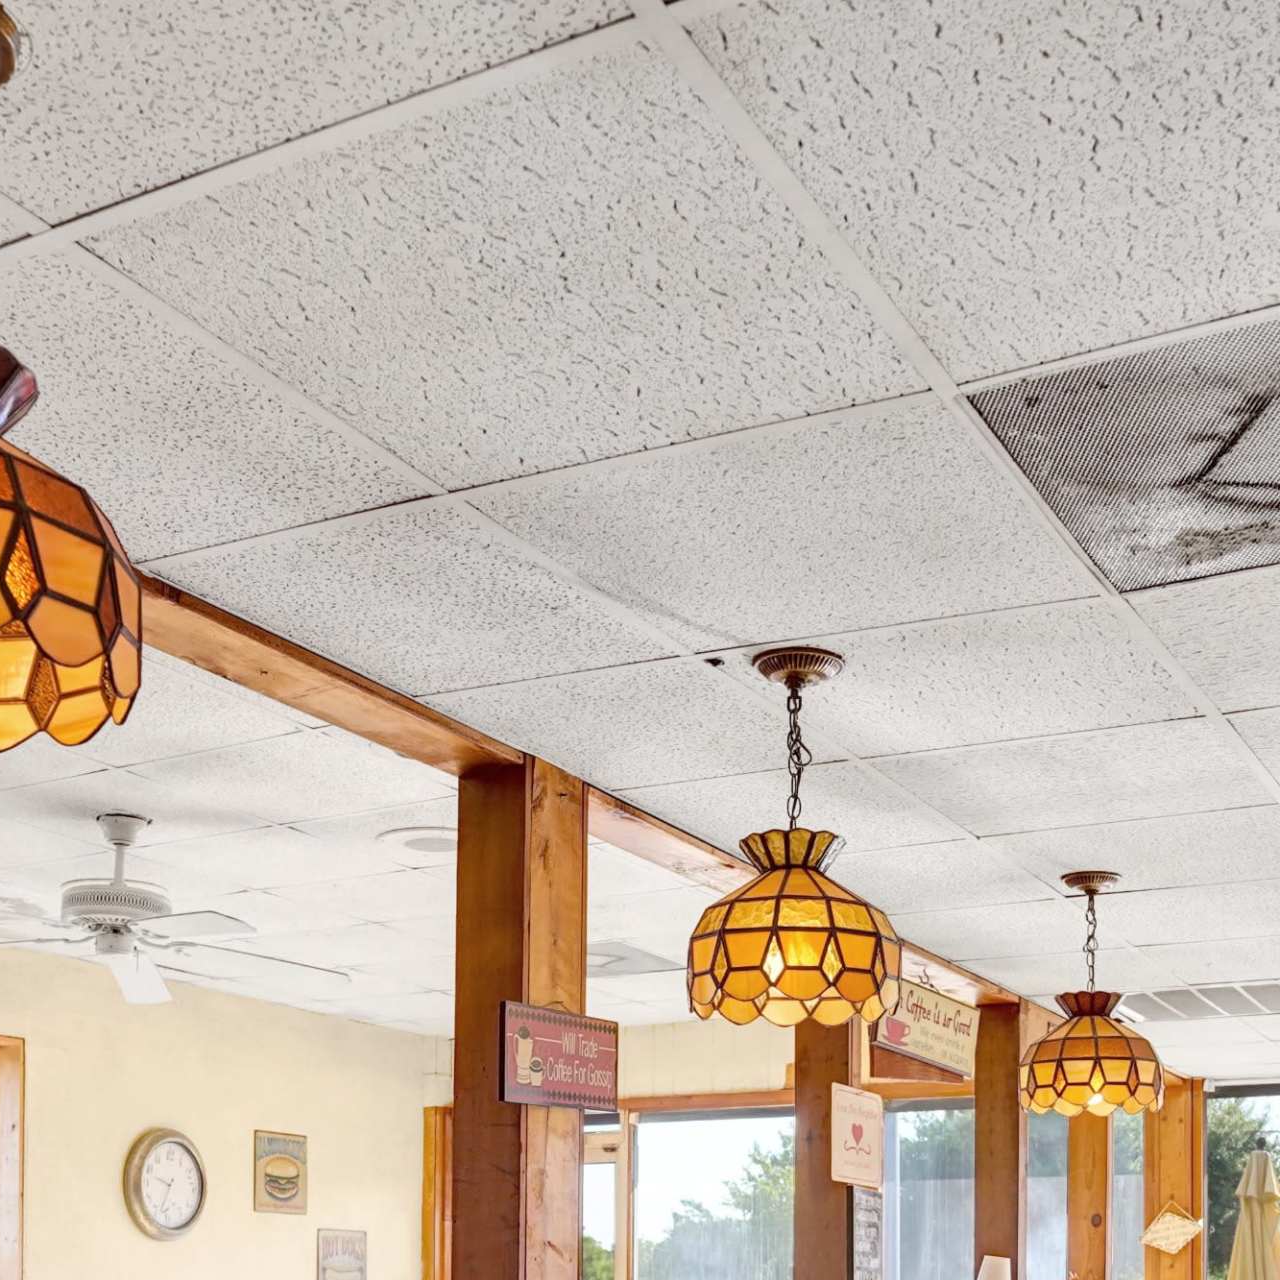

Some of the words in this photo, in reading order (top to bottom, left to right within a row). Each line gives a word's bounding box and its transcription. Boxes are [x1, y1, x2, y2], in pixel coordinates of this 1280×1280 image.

[906, 989, 931, 1023] Coffee
[953, 1009, 973, 1037] Good
[561, 1031, 576, 1056] Will
[578, 1033, 599, 1059] Trade
[546, 1057, 573, 1082] Coffee
[573, 1060, 586, 1084] For
[587, 1062, 613, 1095] Gossip
